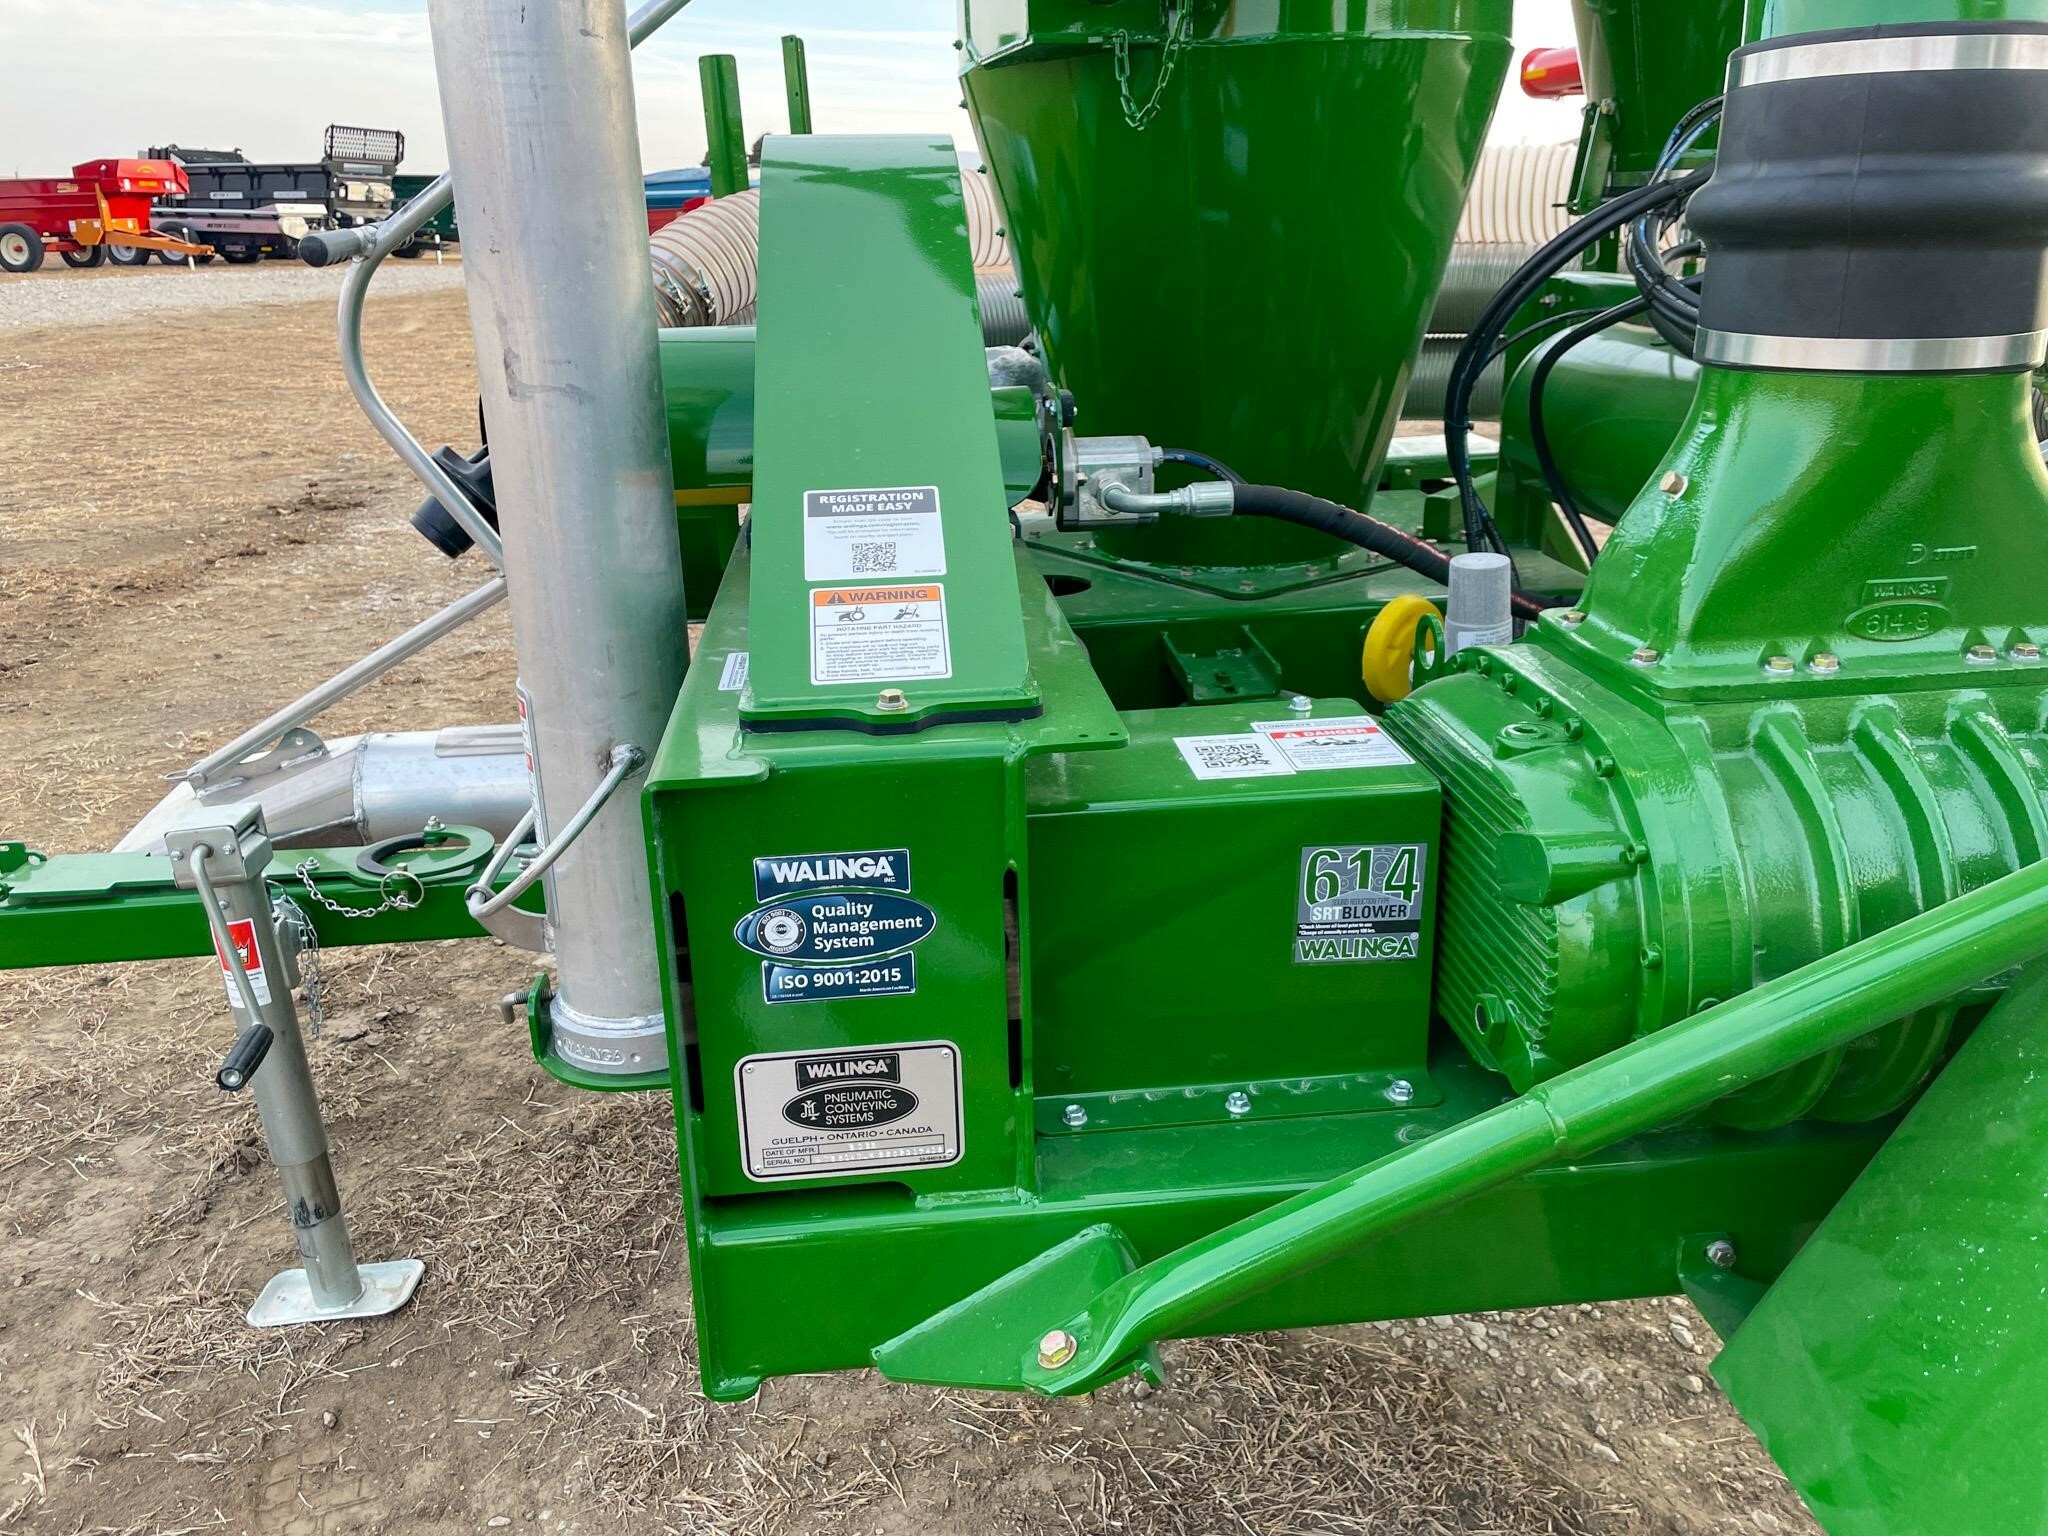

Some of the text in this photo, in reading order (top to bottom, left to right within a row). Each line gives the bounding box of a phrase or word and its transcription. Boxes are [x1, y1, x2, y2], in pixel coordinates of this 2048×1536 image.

[819, 492, 924, 504] REGISTRATION
[832, 502, 912, 513] MADE EASY
[848, 590, 928, 602] WARNING
[1874, 583, 1937, 597] WALINGA
[1302, 728, 1368, 737] DANGER
[771, 856, 894, 884] WALINGA
[1304, 846, 1420, 907] 614
[812, 902, 873, 918] Quality
[813, 915, 922, 935] Management
[814, 935, 874, 952] System
[1299, 936, 1416, 960] WALINGA
[778, 968, 902, 989] ISO 9001:2015
[806, 1058, 888, 1079] WALINGA
[824, 1089, 892, 1104] PNEUMATIC
[825, 1100, 898, 1114] CONVEYING
[826, 1112, 874, 1125] SYSTEMS
[772, 1136, 818, 1146] GUELPH
[826, 1130, 878, 1141] ONTARIO
[886, 1126, 933, 1136] CANADA
[766, 1158, 794, 1166] SERIAL
